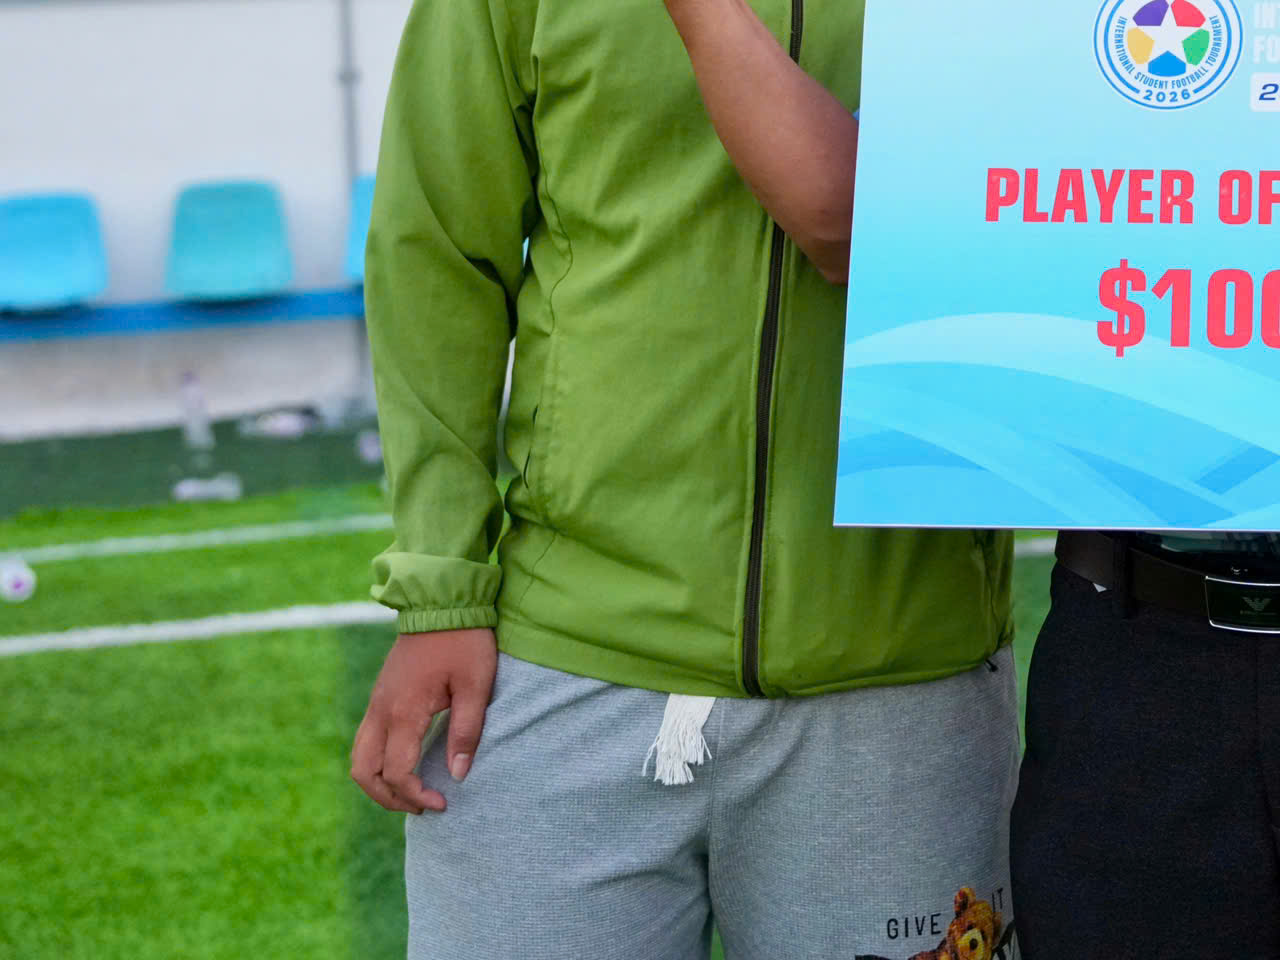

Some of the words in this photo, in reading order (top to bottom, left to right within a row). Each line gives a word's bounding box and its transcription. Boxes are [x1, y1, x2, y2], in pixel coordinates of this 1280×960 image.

[1114, 15, 1136, 75] INTERNATIONAL
[1134, 71, 1169, 89] STUDENT
[1171, 65, 1209, 89] FOOTBALL
[1205, 15, 1223, 67] TOURNAMENT
[1143, 88, 1191, 103] 2026
[985, 167, 1194, 224] PLAYER
[886, 912, 942, 940] GIVE
